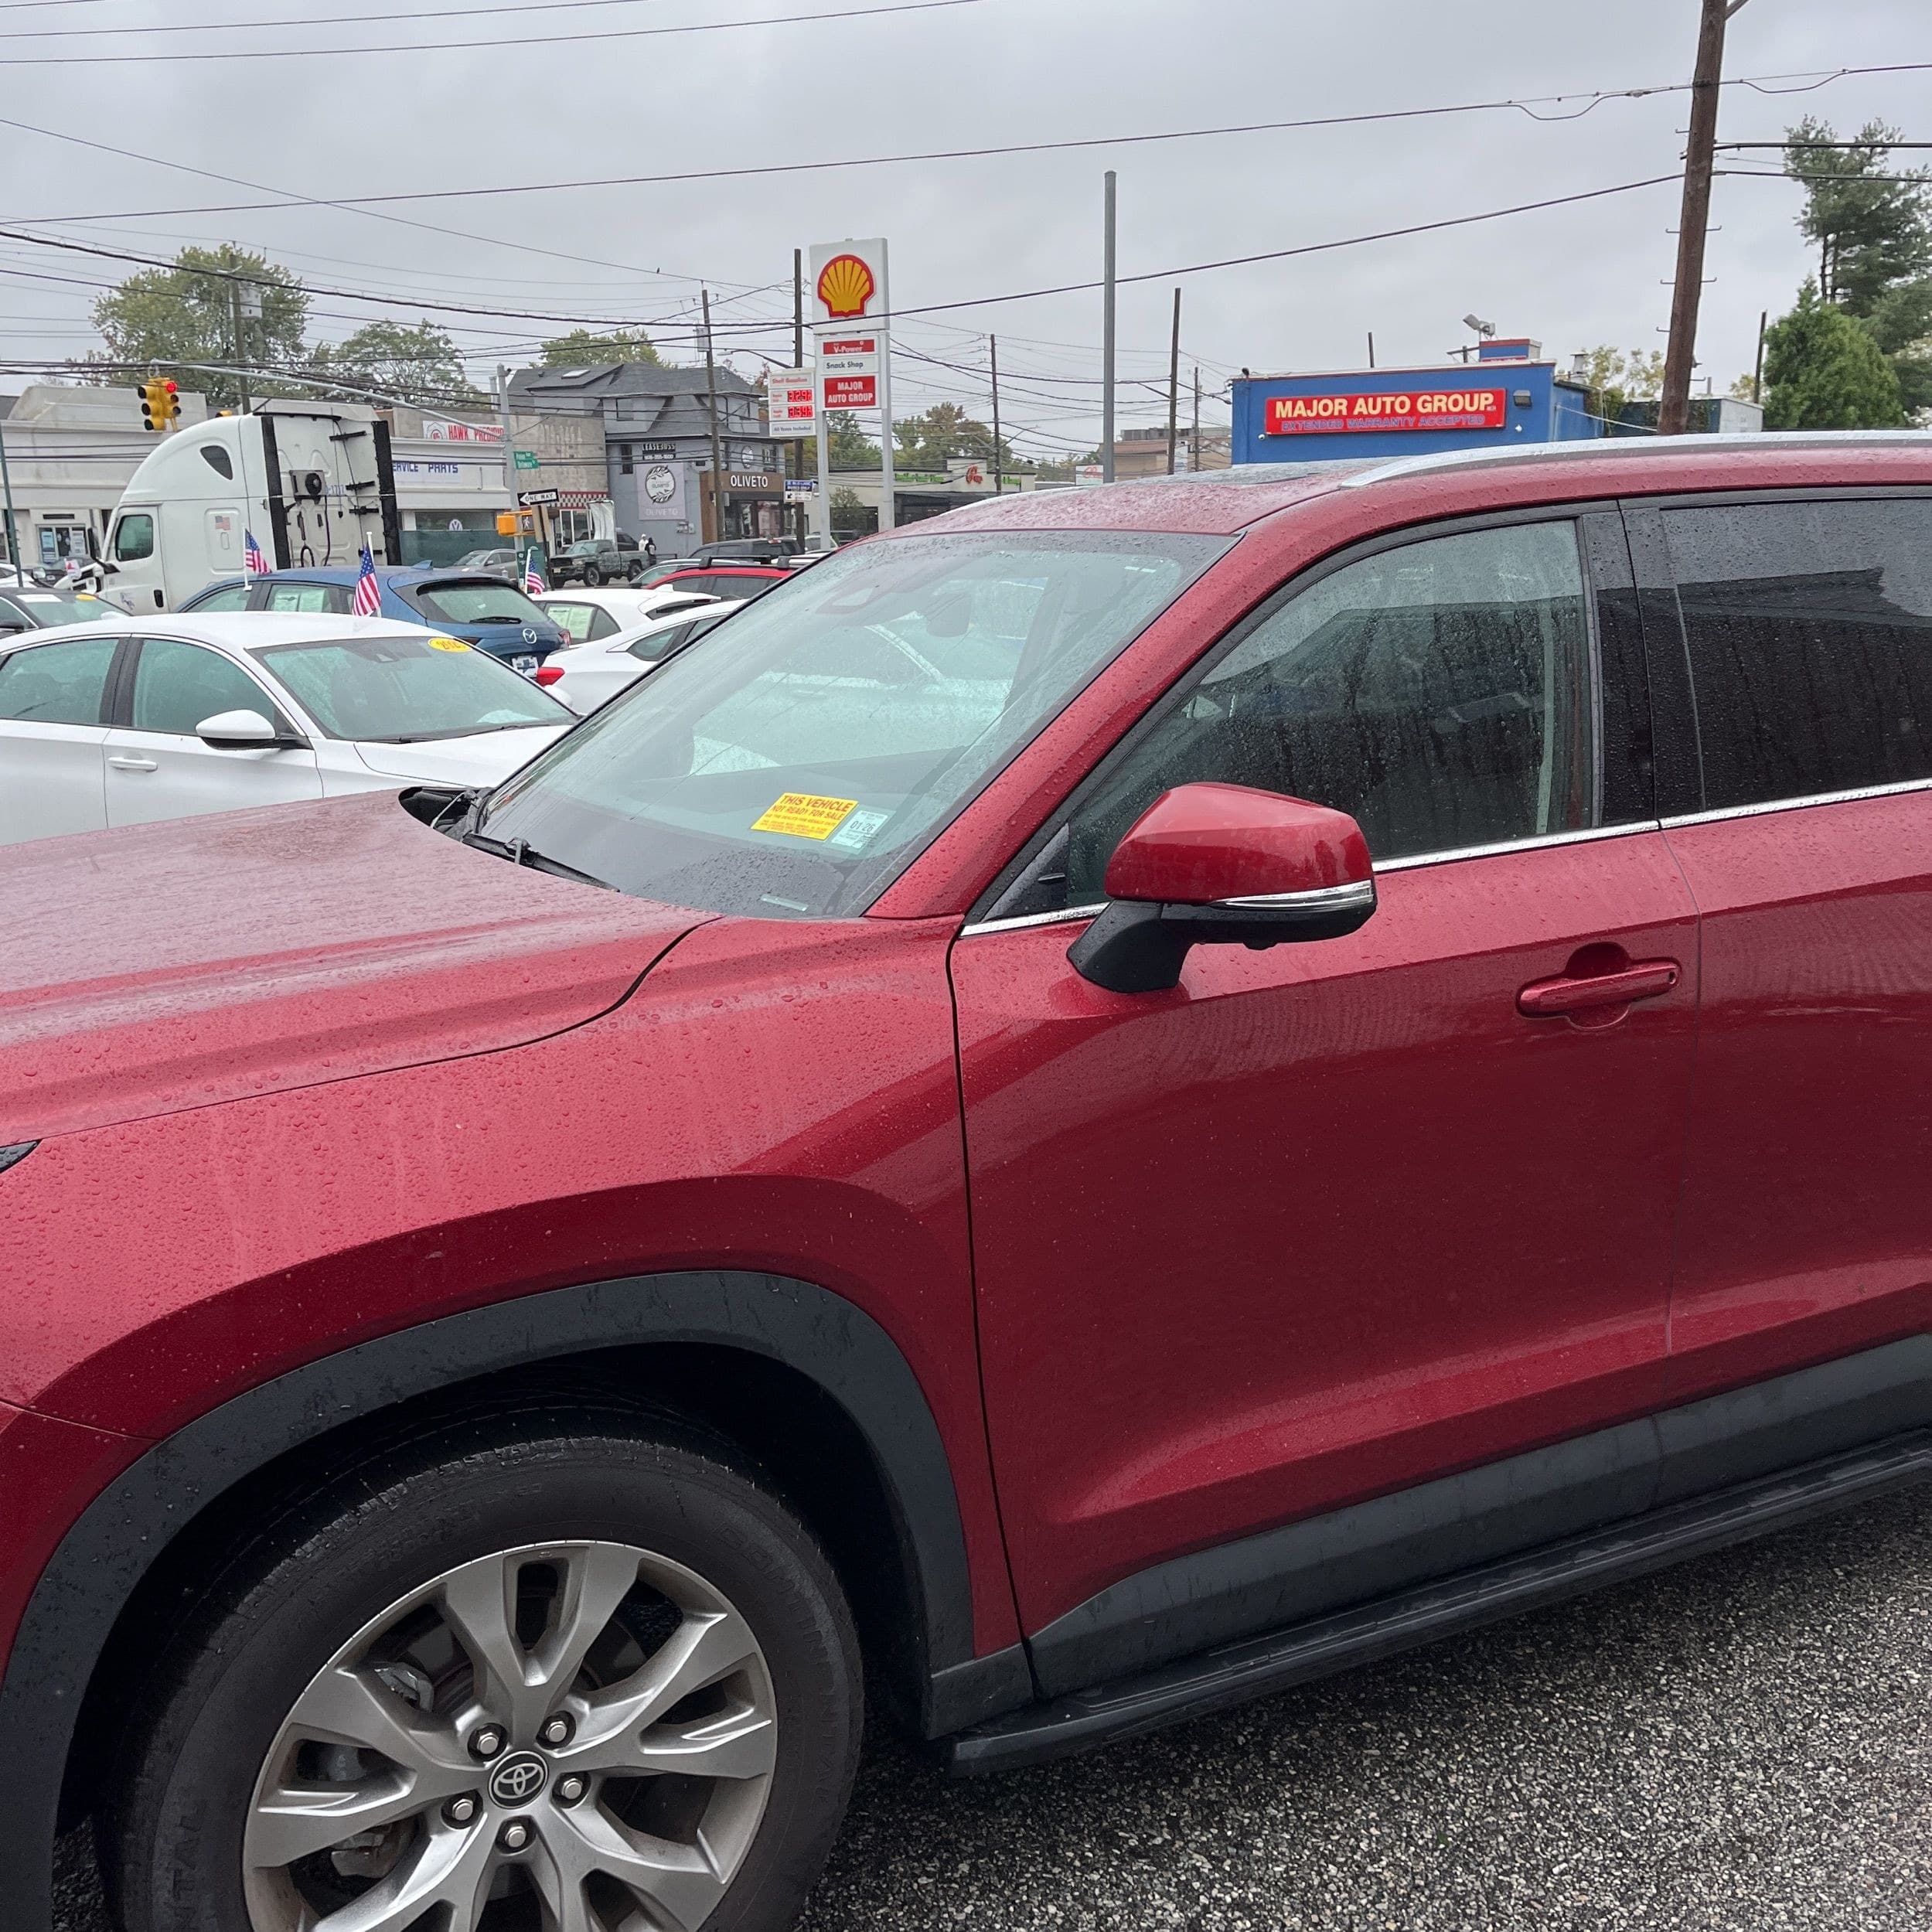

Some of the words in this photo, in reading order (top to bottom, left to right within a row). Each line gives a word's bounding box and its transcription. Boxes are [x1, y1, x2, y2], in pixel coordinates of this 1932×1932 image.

[847, 360, 864, 369] Shop
[837, 381, 864, 390] MAJOR
[828, 394, 847, 403] AUTO
[848, 393, 874, 402] GROUP
[1276, 398, 1348, 418] MAJOR
[1353, 395, 1412, 415] AUTO
[1416, 393, 1494, 413] GROUP
[1282, 419, 1344, 431] EXTENDED
[1347, 416, 1416, 428] WARRANTY
[1418, 414, 1485, 426] ACCEPTED
[448, 424, 469, 441] HAWK
[393, 462, 419, 472] ERVICE
[428, 462, 458, 473] PARTS
[730, 475, 768, 488] OLIVETO
[779, 795, 806, 806] THIS
[806, 798, 854, 813] VEHICLE
[786, 806, 809, 816] READY
[824, 812, 845, 820] SALE
